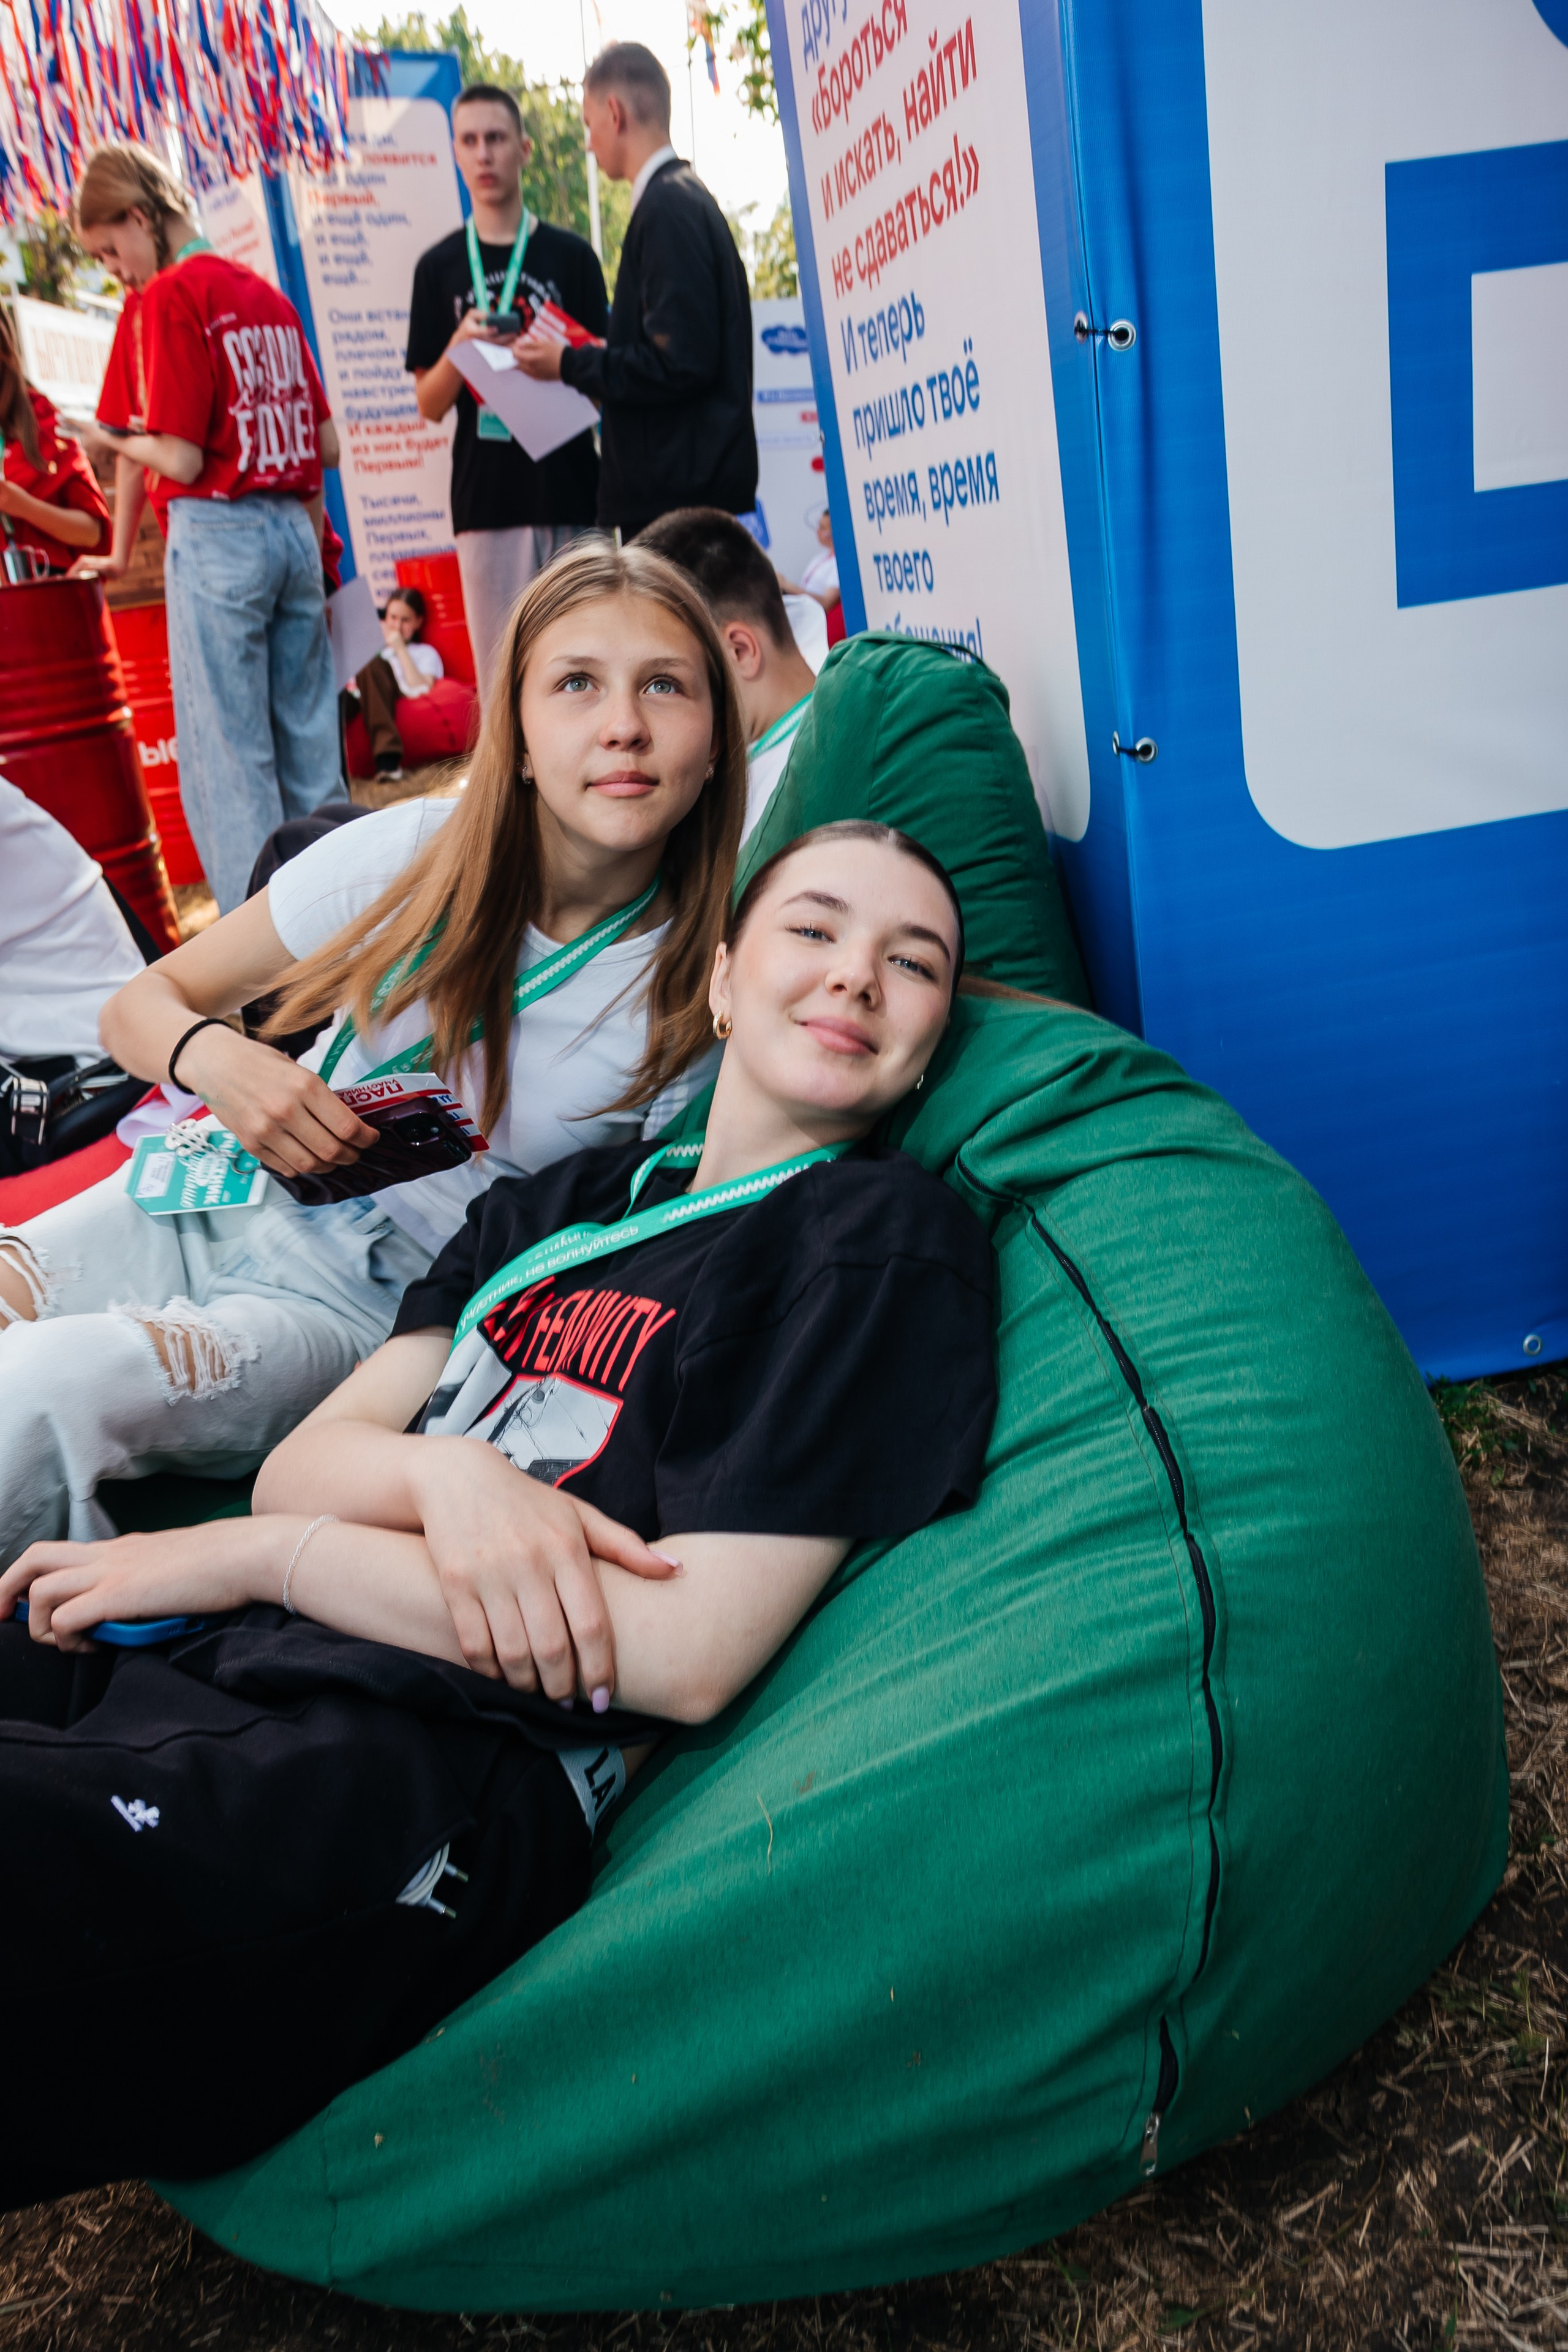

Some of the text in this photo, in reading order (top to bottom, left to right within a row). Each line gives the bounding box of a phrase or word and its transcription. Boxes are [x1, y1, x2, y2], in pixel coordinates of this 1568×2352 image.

[821, 15, 978, 222] и искать, найти
[831, 131, 979, 300] не сдаваться!»
[840, 315, 858, 375] И
[858, 290, 925, 365] теперь
[853, 336, 981, 462] пришло твоё
[863, 450, 1000, 535] время, время
[873, 549, 934, 594] твоего
[526, 1263, 545, 1280] не
[548, 1226, 639, 1268] волнуйтесь
